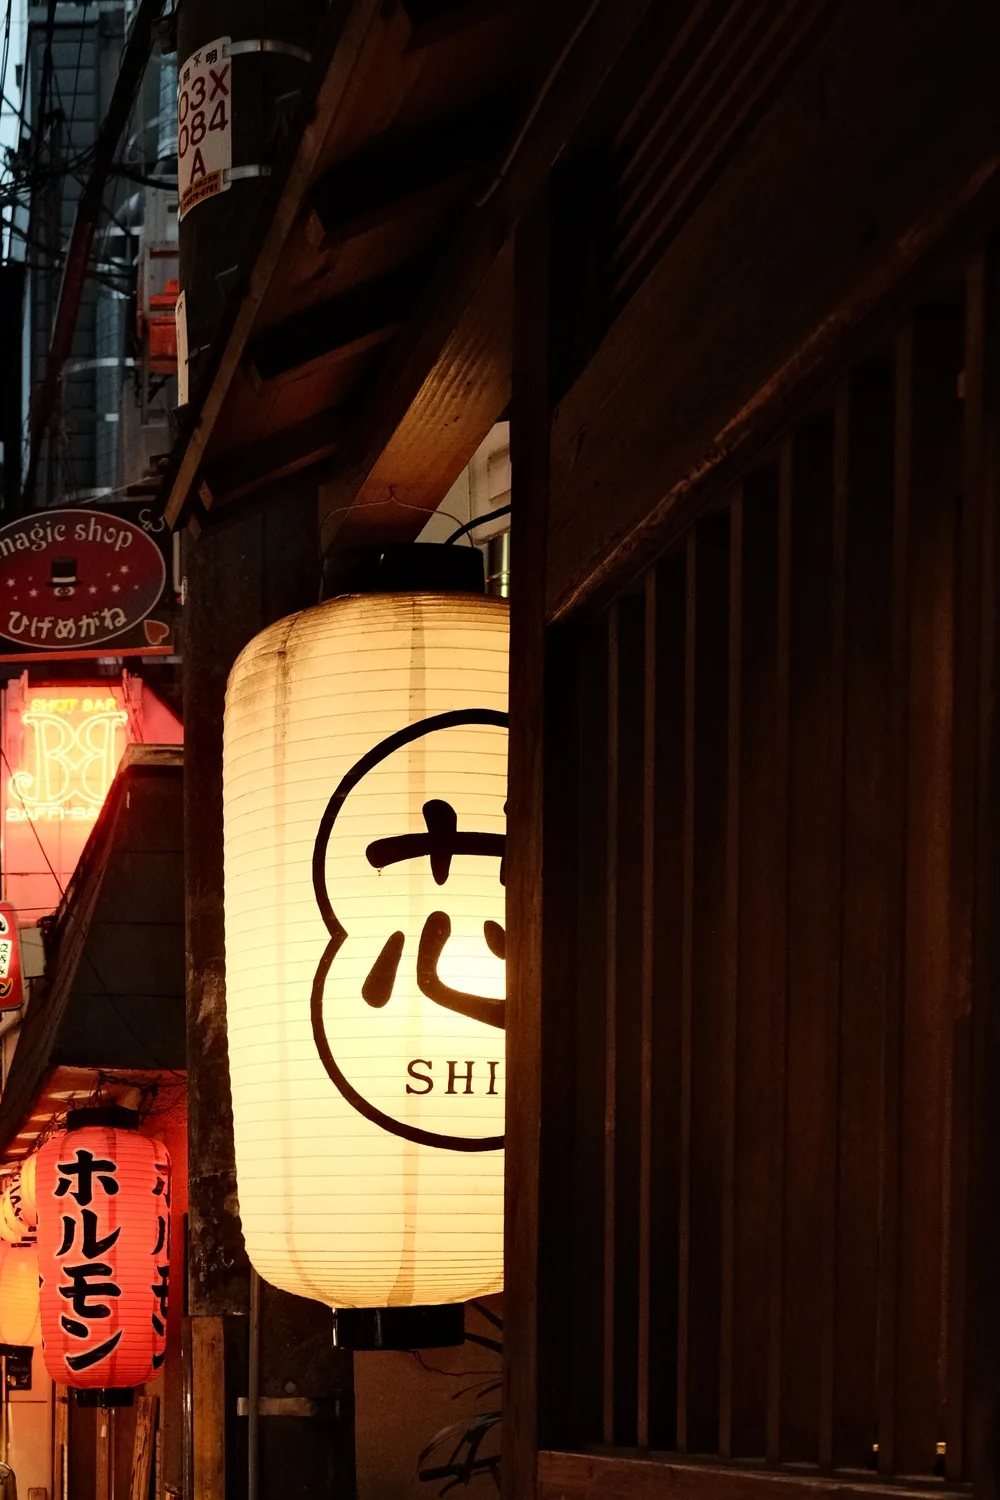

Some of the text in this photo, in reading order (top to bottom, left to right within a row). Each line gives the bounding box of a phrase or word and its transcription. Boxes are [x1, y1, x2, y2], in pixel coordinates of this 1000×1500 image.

[178, 100, 229, 160] 084
[190, 148, 207, 183] A
[74, 516, 133, 551] shop
[8, 607, 128, 640] ひげめがね
[30, 698, 117, 713] SHOT BAR
[54, 1149, 123, 1372] ホルモン
